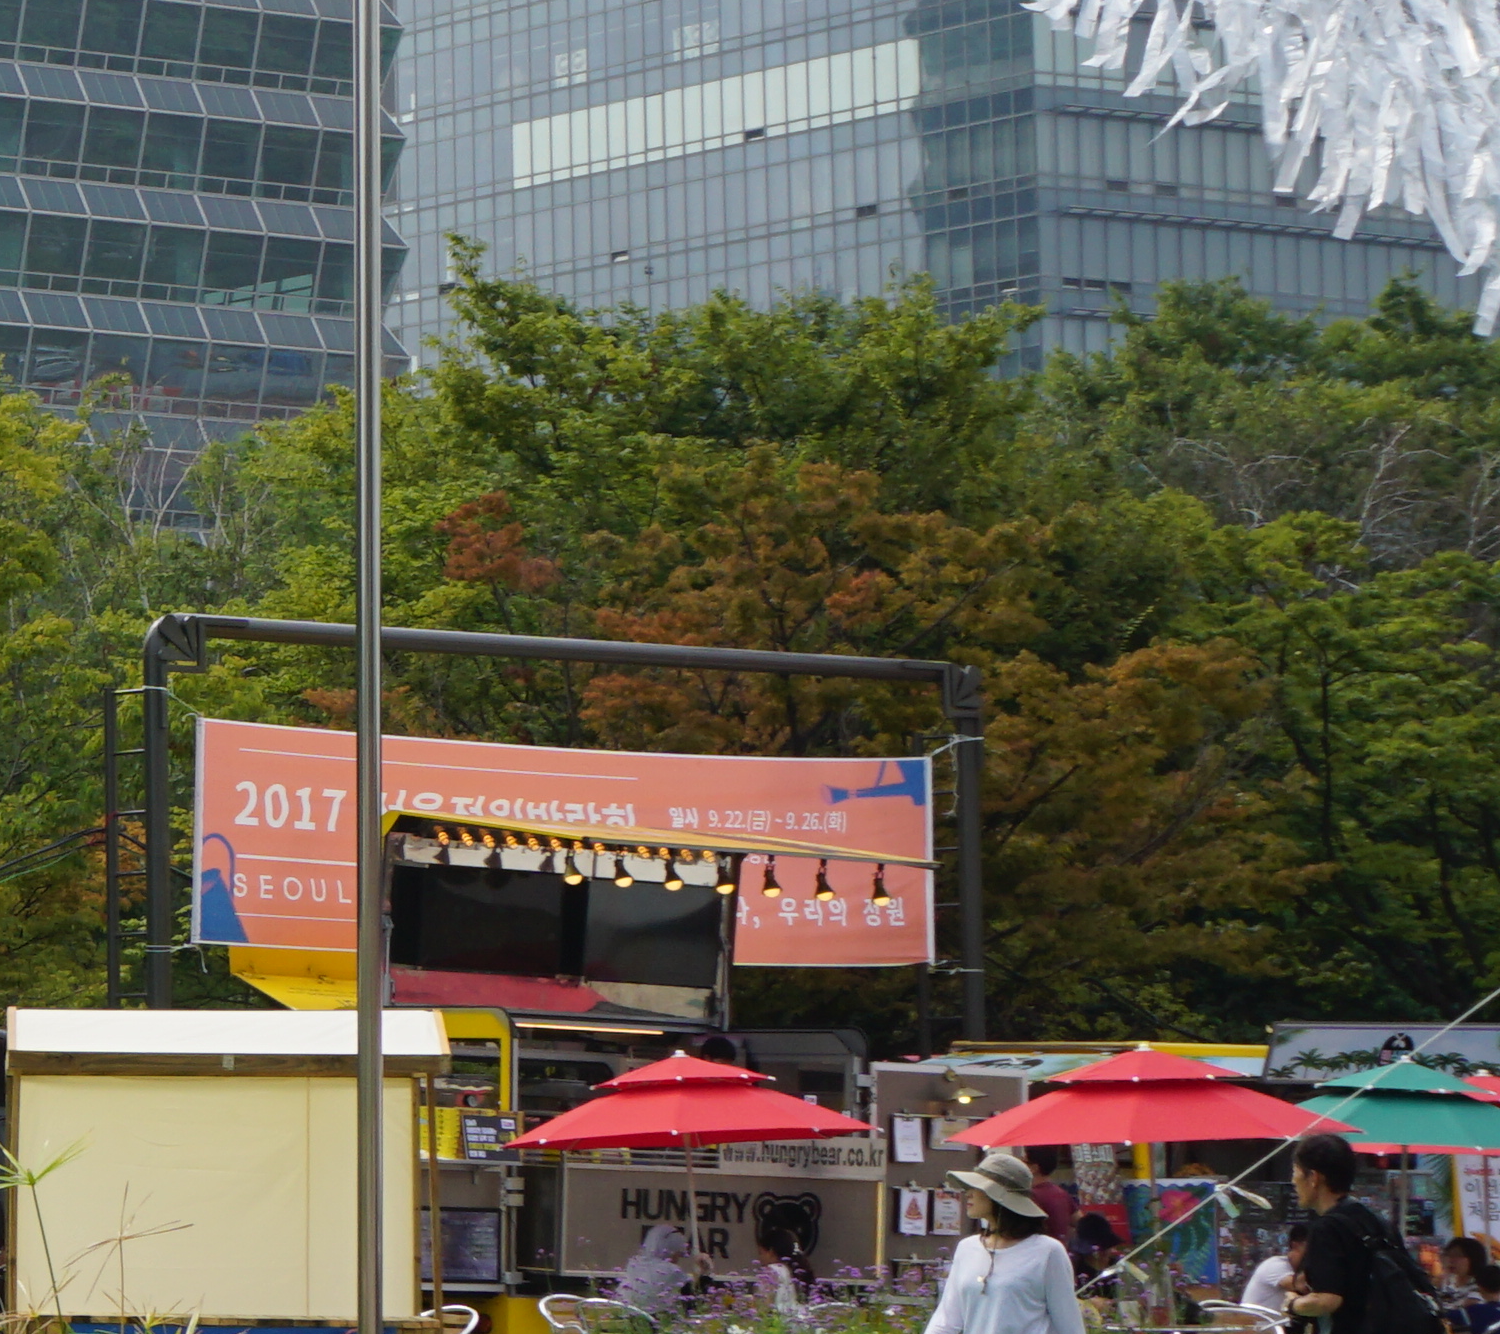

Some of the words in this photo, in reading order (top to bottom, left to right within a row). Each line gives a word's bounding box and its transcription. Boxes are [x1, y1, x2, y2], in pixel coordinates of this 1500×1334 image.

[233, 780, 347, 833] 2017
[668, 807, 699, 829] 일시
[233, 871, 353, 904] SEOUL
[778, 897, 847, 927] 우리의
[863, 896, 906, 927] 정원
[722, 1141, 885, 1168] www.hungrybear.co.kr
[621, 1187, 752, 1224] HUNGRY
